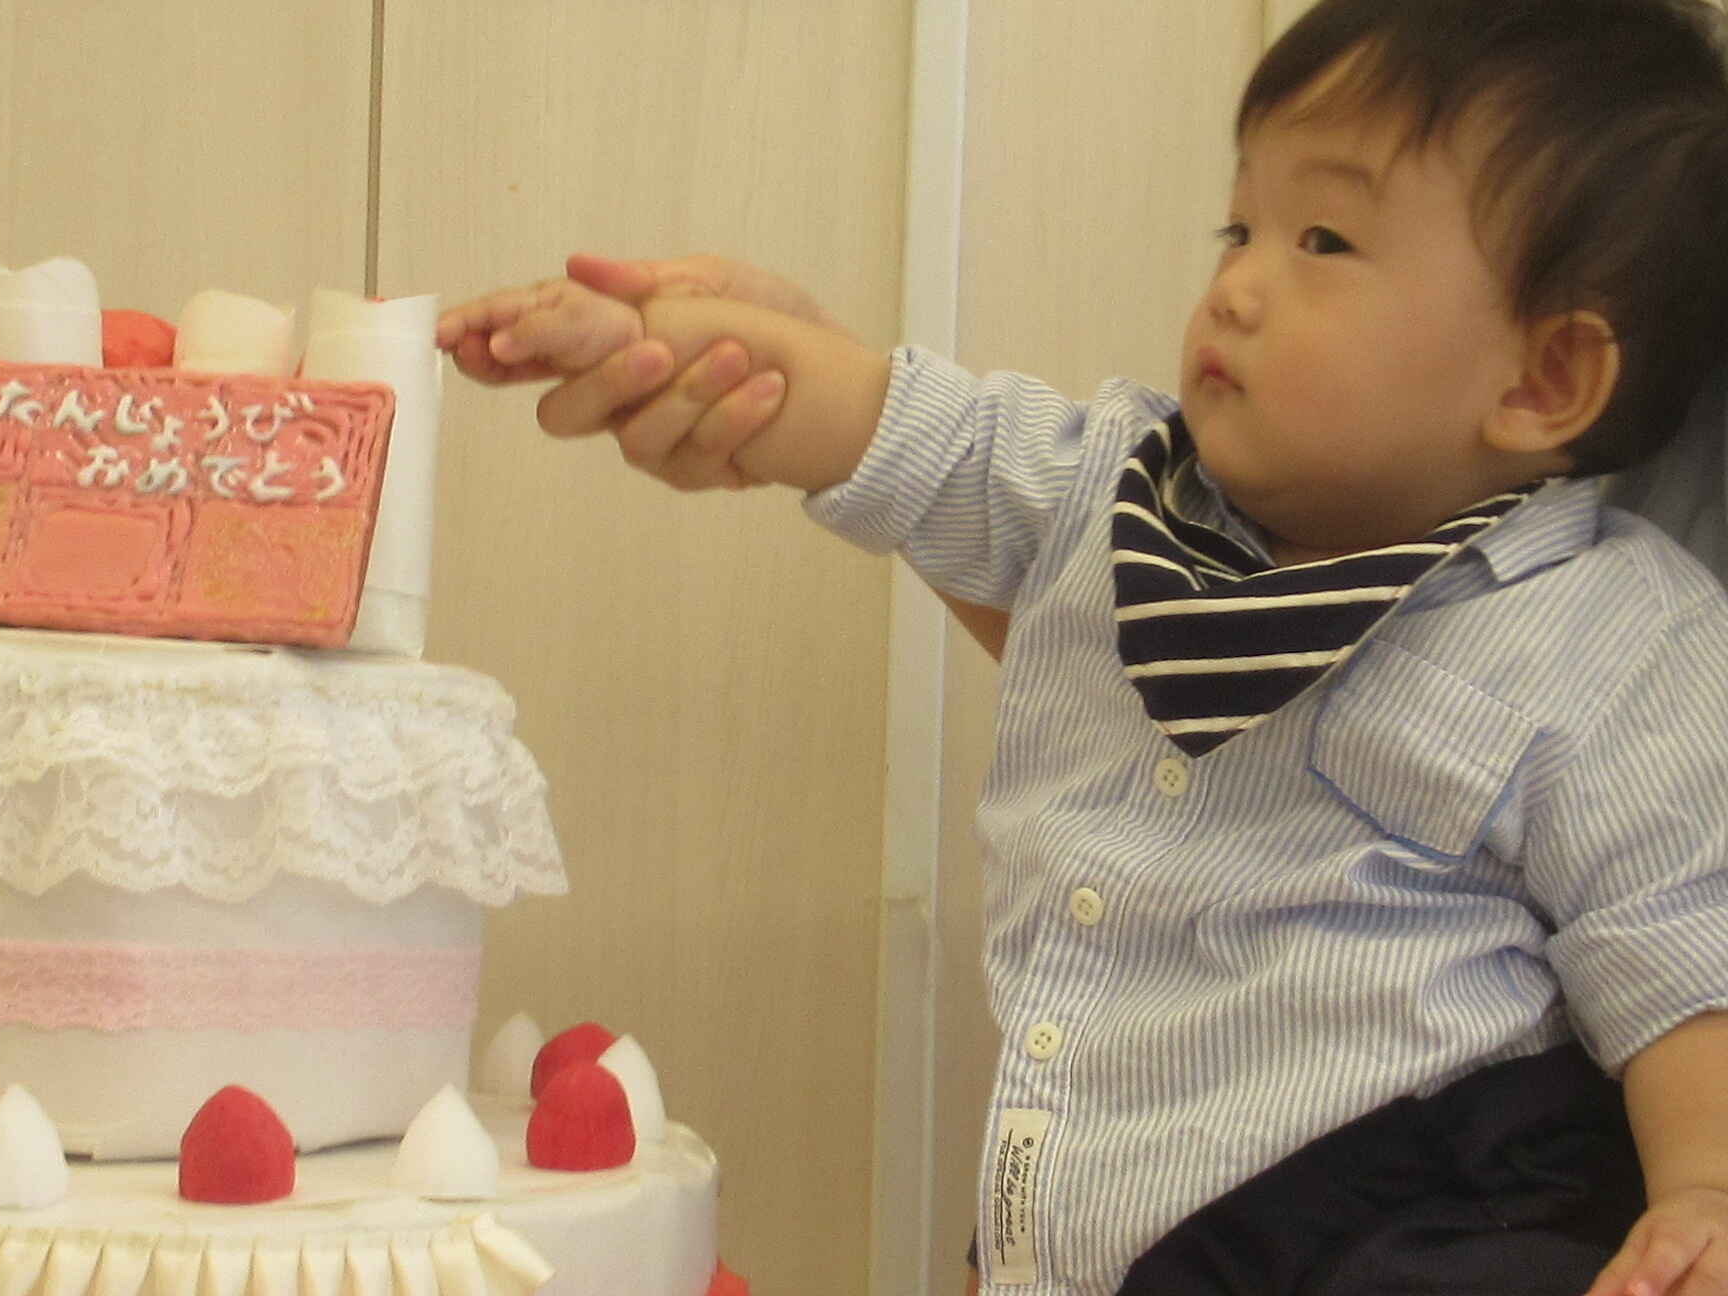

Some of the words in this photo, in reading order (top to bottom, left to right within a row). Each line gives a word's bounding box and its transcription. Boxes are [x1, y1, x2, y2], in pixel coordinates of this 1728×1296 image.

[76, 444, 347, 502] おめでとう
